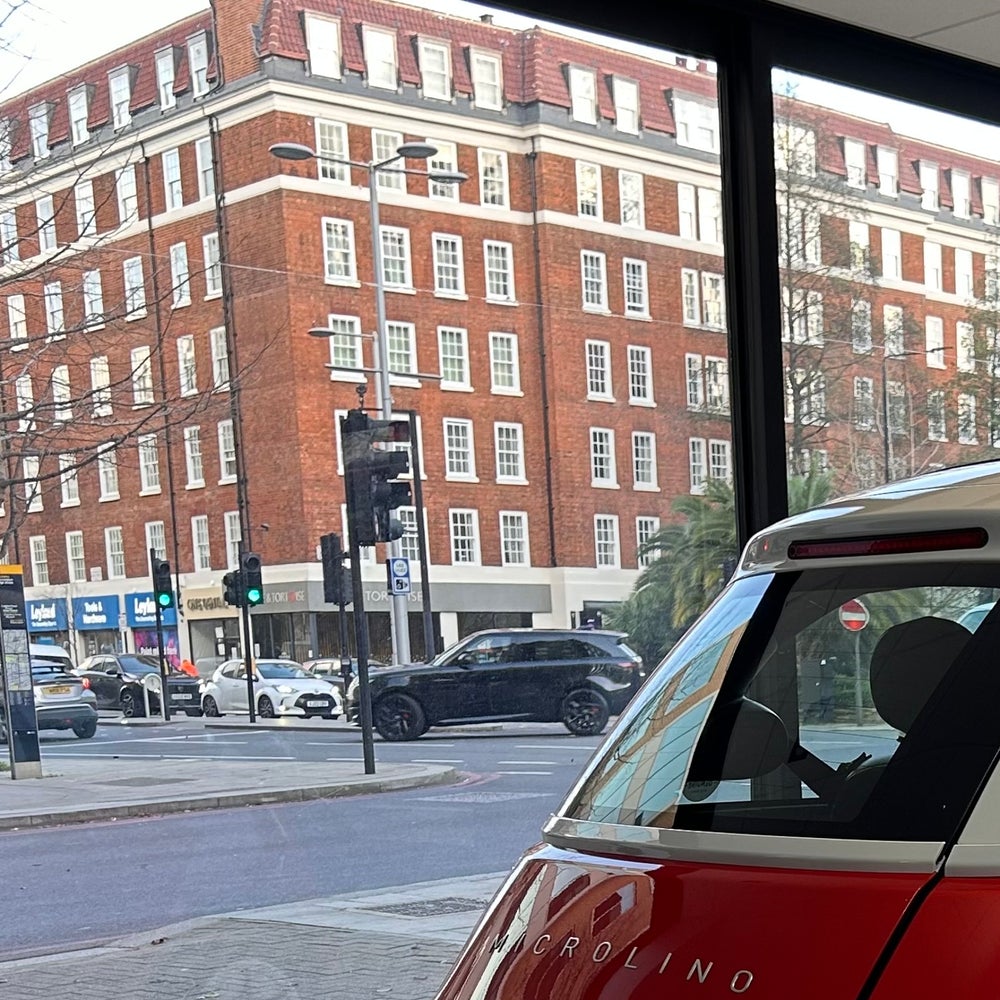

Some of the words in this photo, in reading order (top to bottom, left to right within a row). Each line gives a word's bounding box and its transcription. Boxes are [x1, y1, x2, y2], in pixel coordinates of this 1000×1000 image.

[365, 591, 423, 602] TORISE
[134, 597, 163, 616] Leyla
[488, 933, 753, 994] MICROLINO
